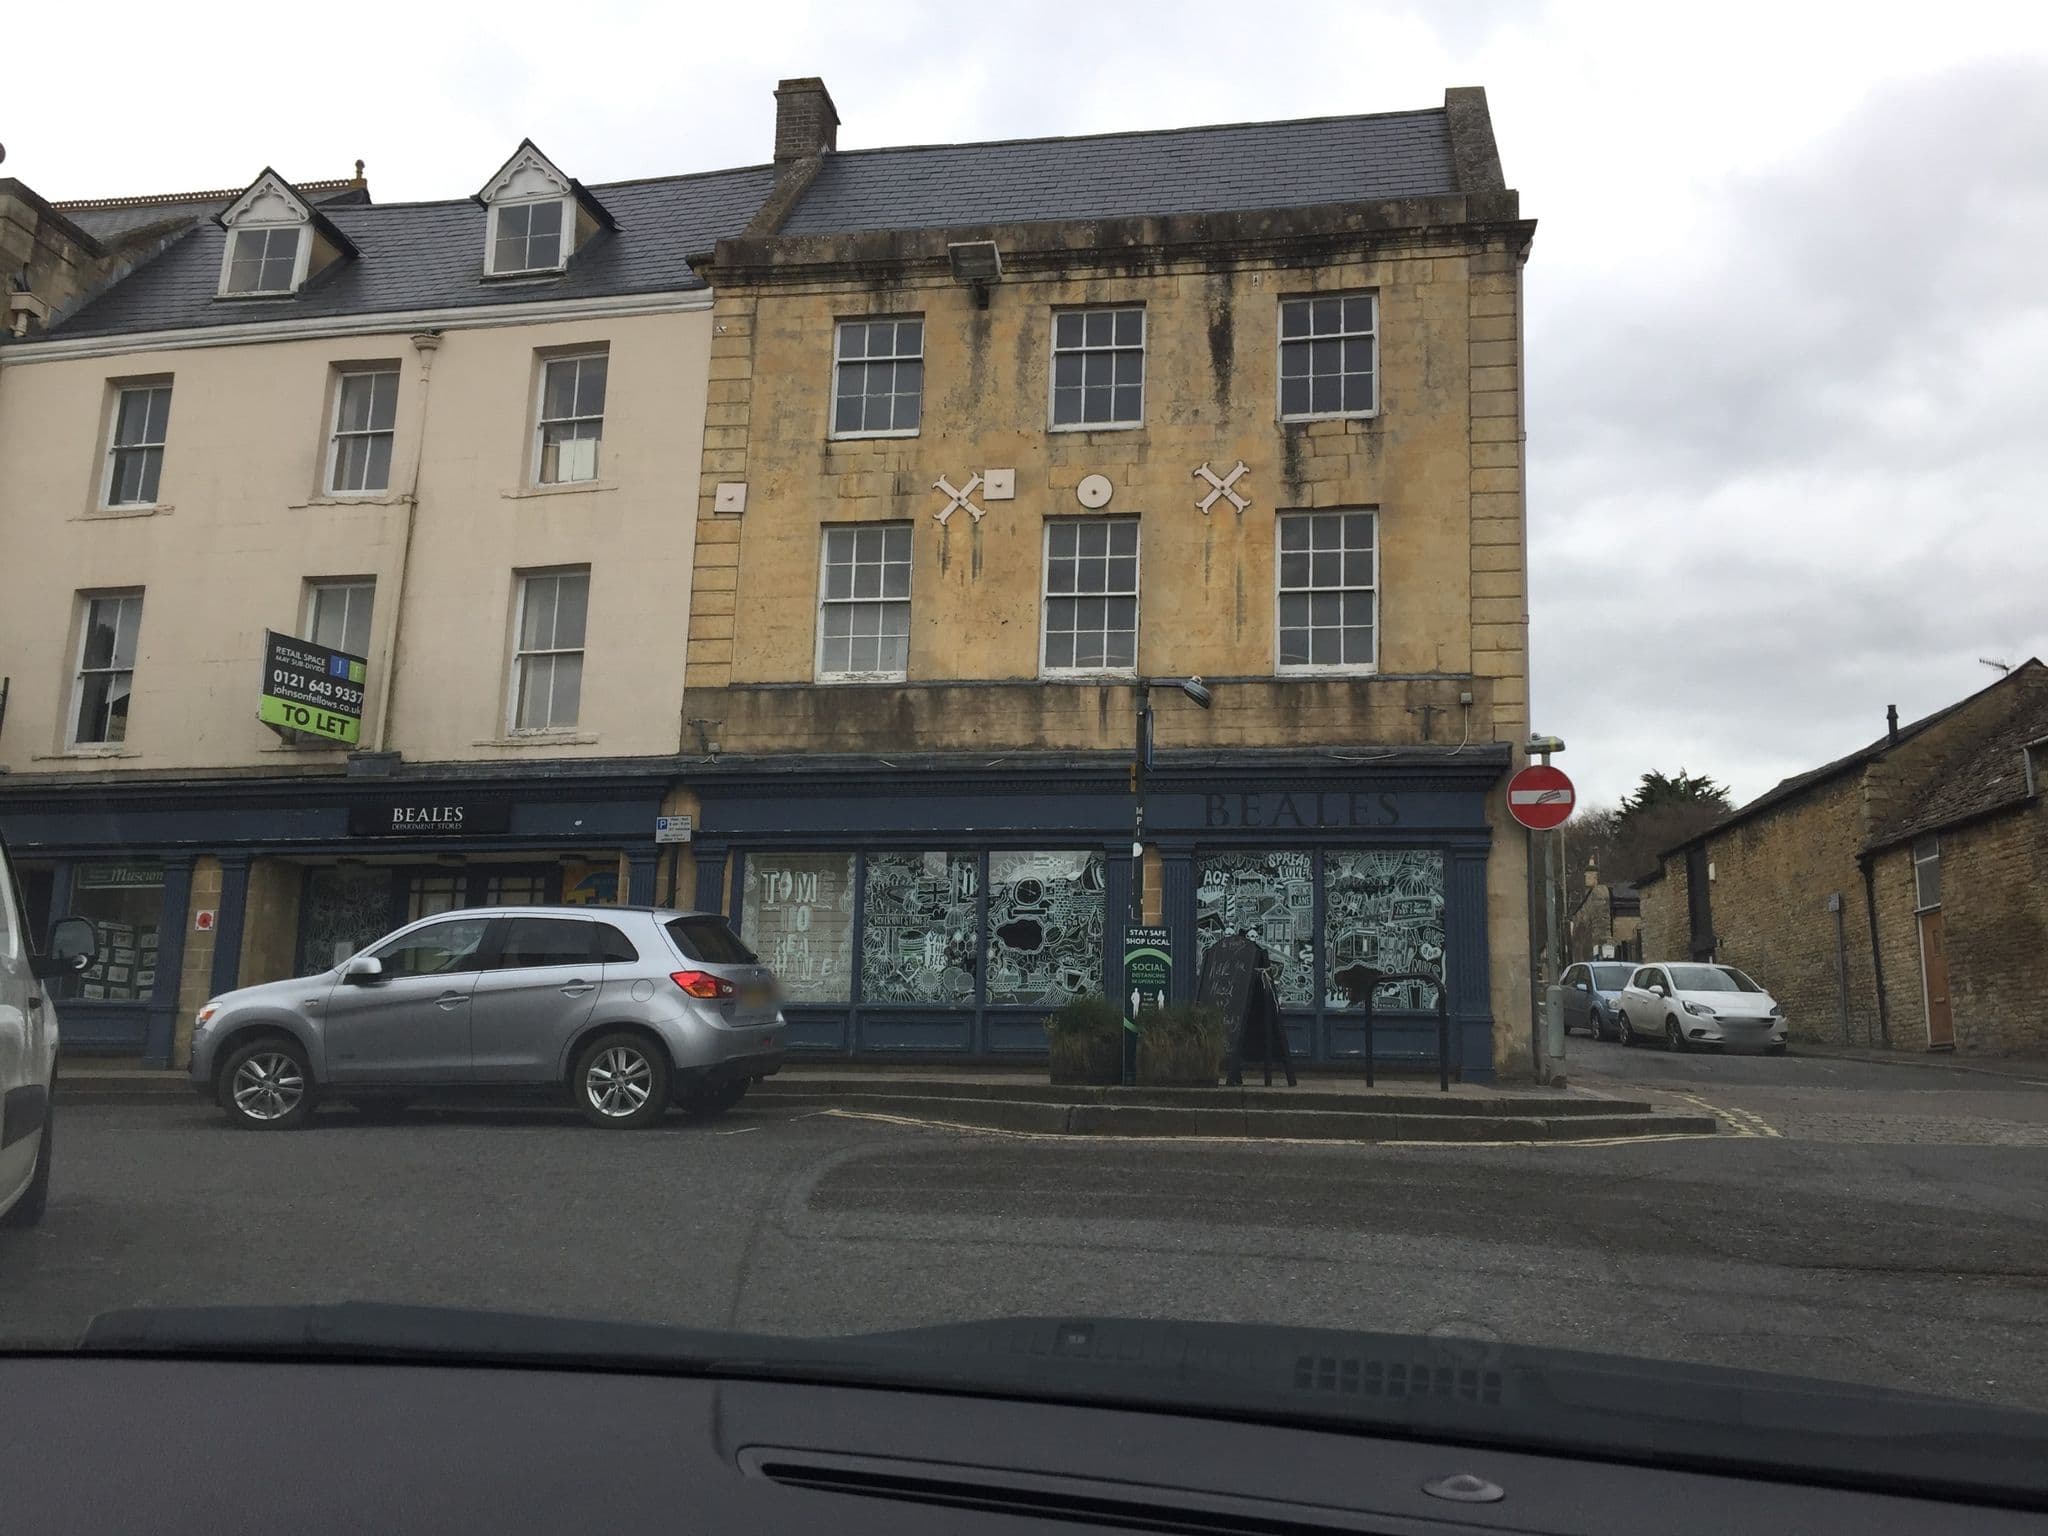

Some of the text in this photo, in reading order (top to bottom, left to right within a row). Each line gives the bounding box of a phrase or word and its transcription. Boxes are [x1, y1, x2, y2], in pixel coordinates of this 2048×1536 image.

[275, 646, 326, 667] RETAIL SPACE
[290, 658, 326, 674] SUB-DIVIDE
[274, 669, 364, 704] 0121 643 9337
[273, 684, 362, 714] johnsonfellows.co.uk
[282, 704, 351, 736] TO LET
[392, 806, 464, 822] BEALES
[1203, 792, 1400, 828] BEALES
[1268, 852, 1311, 868] SPREAD
[112, 868, 164, 882] Museum
[1129, 929, 1148, 937] STAY
[1146, 938, 1170, 946] LOCAL
[1131, 963, 1165, 971] SOCIAL
